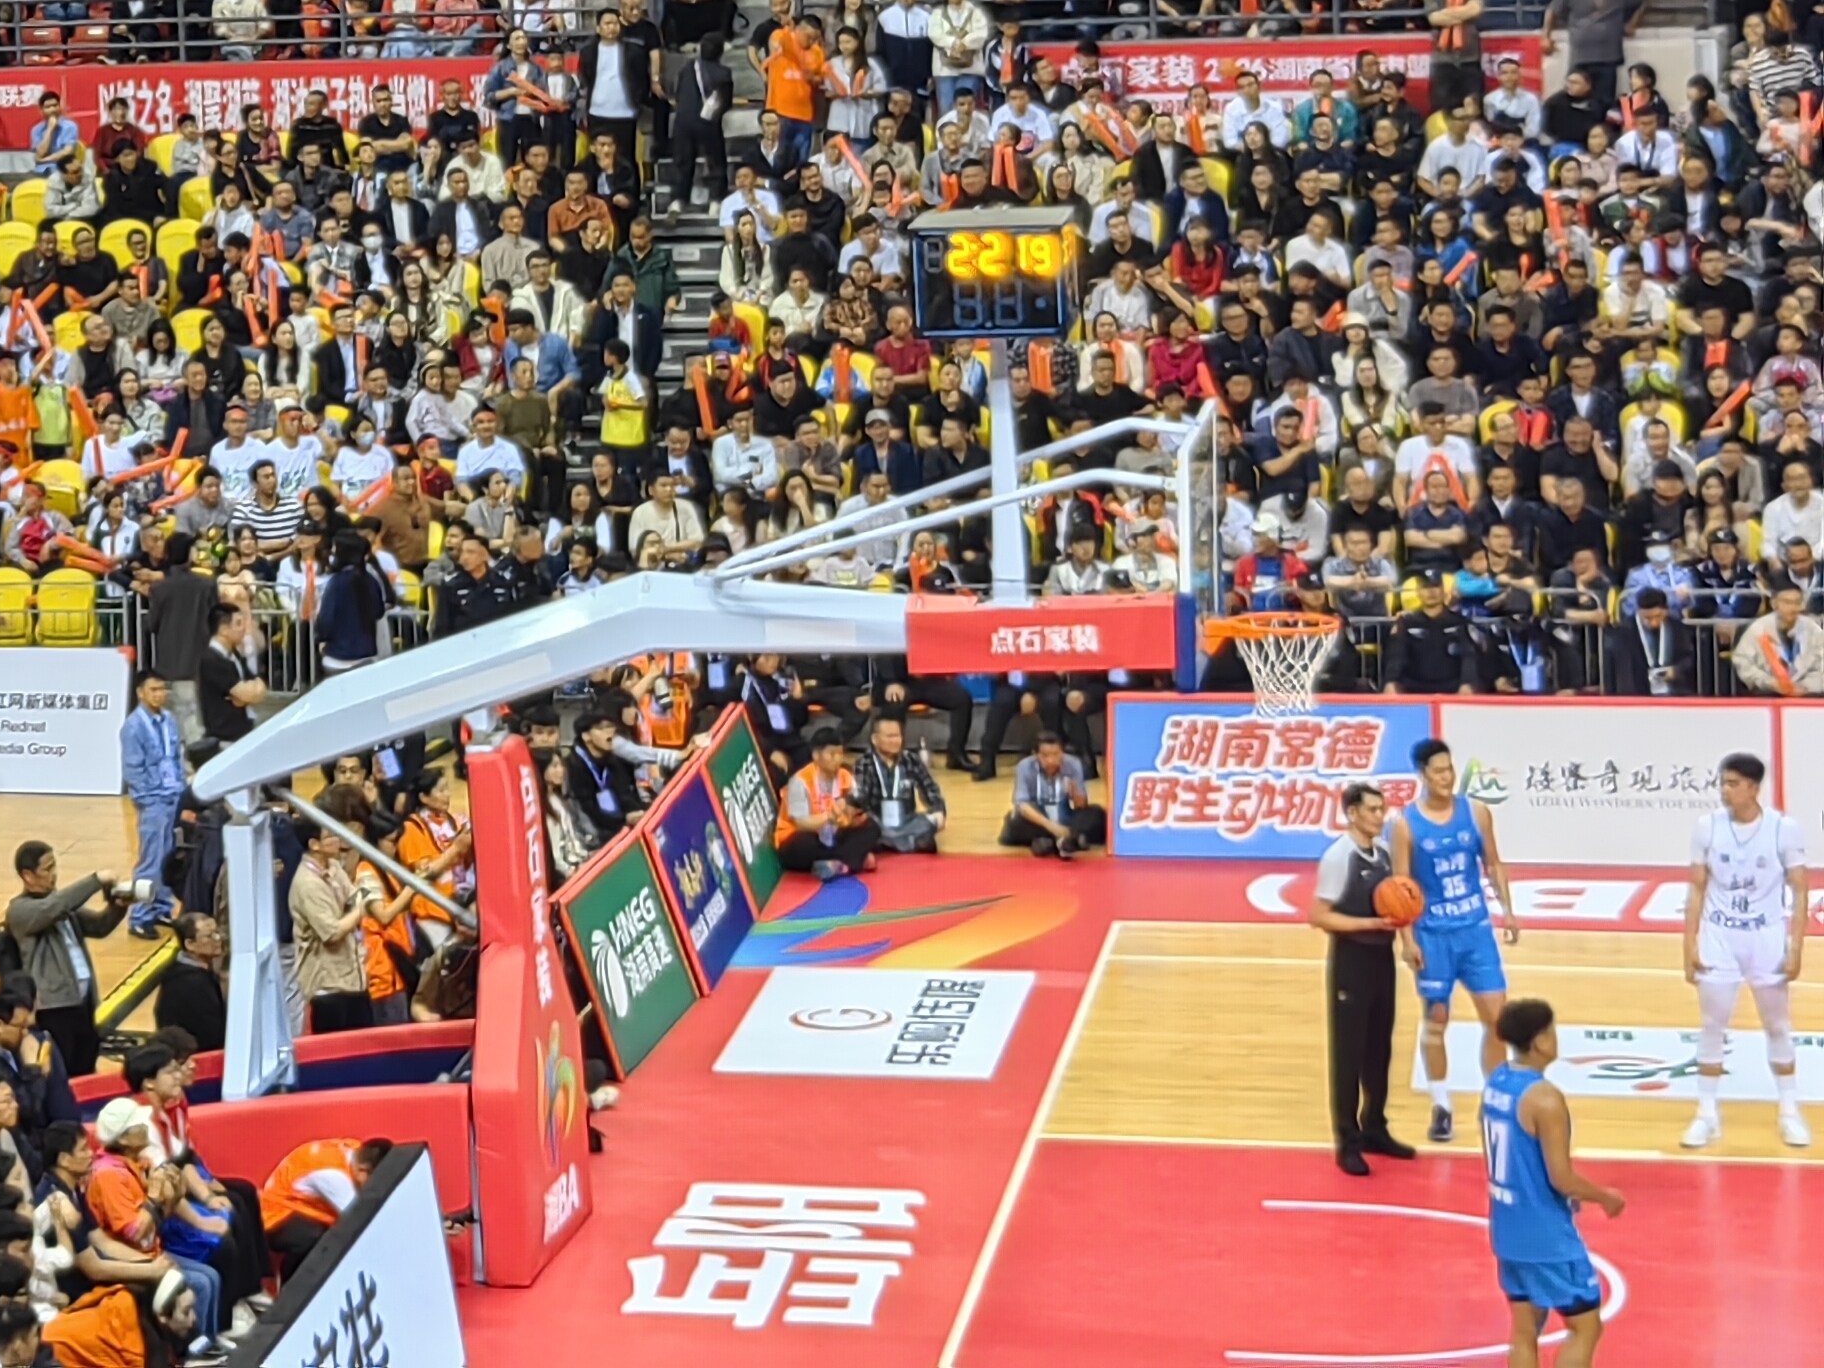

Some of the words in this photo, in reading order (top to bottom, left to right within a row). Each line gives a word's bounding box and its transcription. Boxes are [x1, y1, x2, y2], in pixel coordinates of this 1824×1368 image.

[990, 625, 1101, 655] 点石家装
[27, 742, 67, 757] Group
[1161, 715, 1384, 773] 湖南常德
